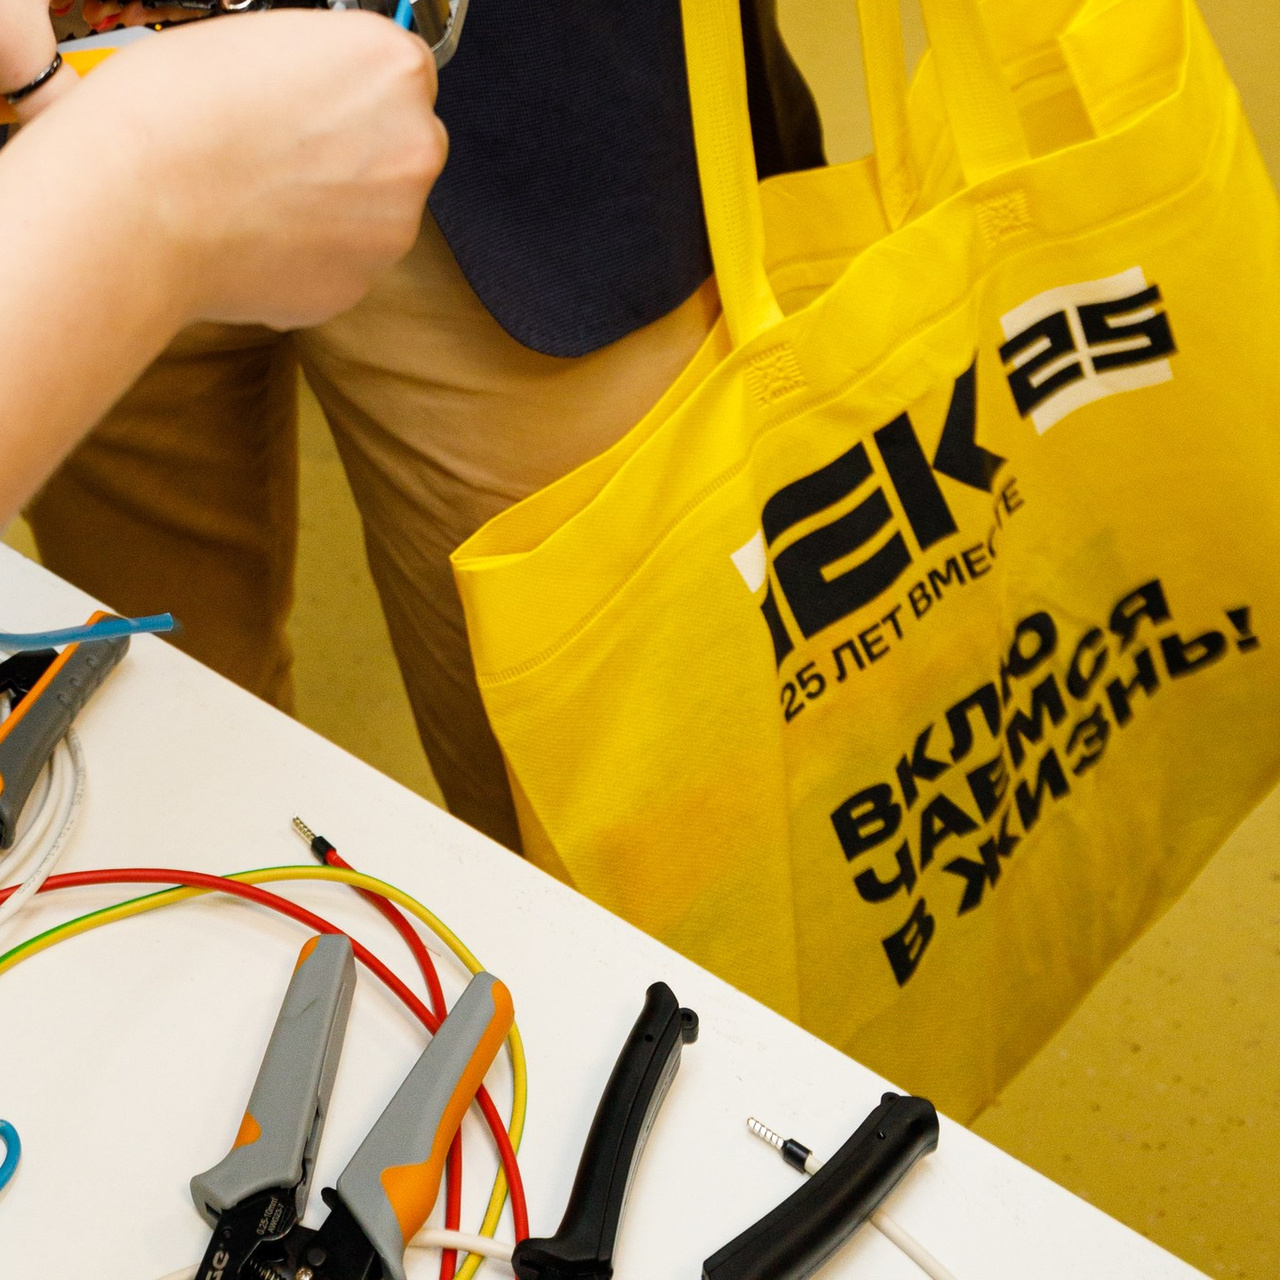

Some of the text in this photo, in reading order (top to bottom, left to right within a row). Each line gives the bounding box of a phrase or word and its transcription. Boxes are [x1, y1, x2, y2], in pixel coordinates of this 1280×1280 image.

[998, 283, 1179, 420] 25
[780, 660, 827, 724] 25
[831, 604, 904, 683] ЛЕТ
[829, 610, 1059, 864] ВКЛЮ
[852, 577, 1173, 906] ЧАЕМСЯ
[881, 604, 1262, 990] В ЖИЗНЬ!
